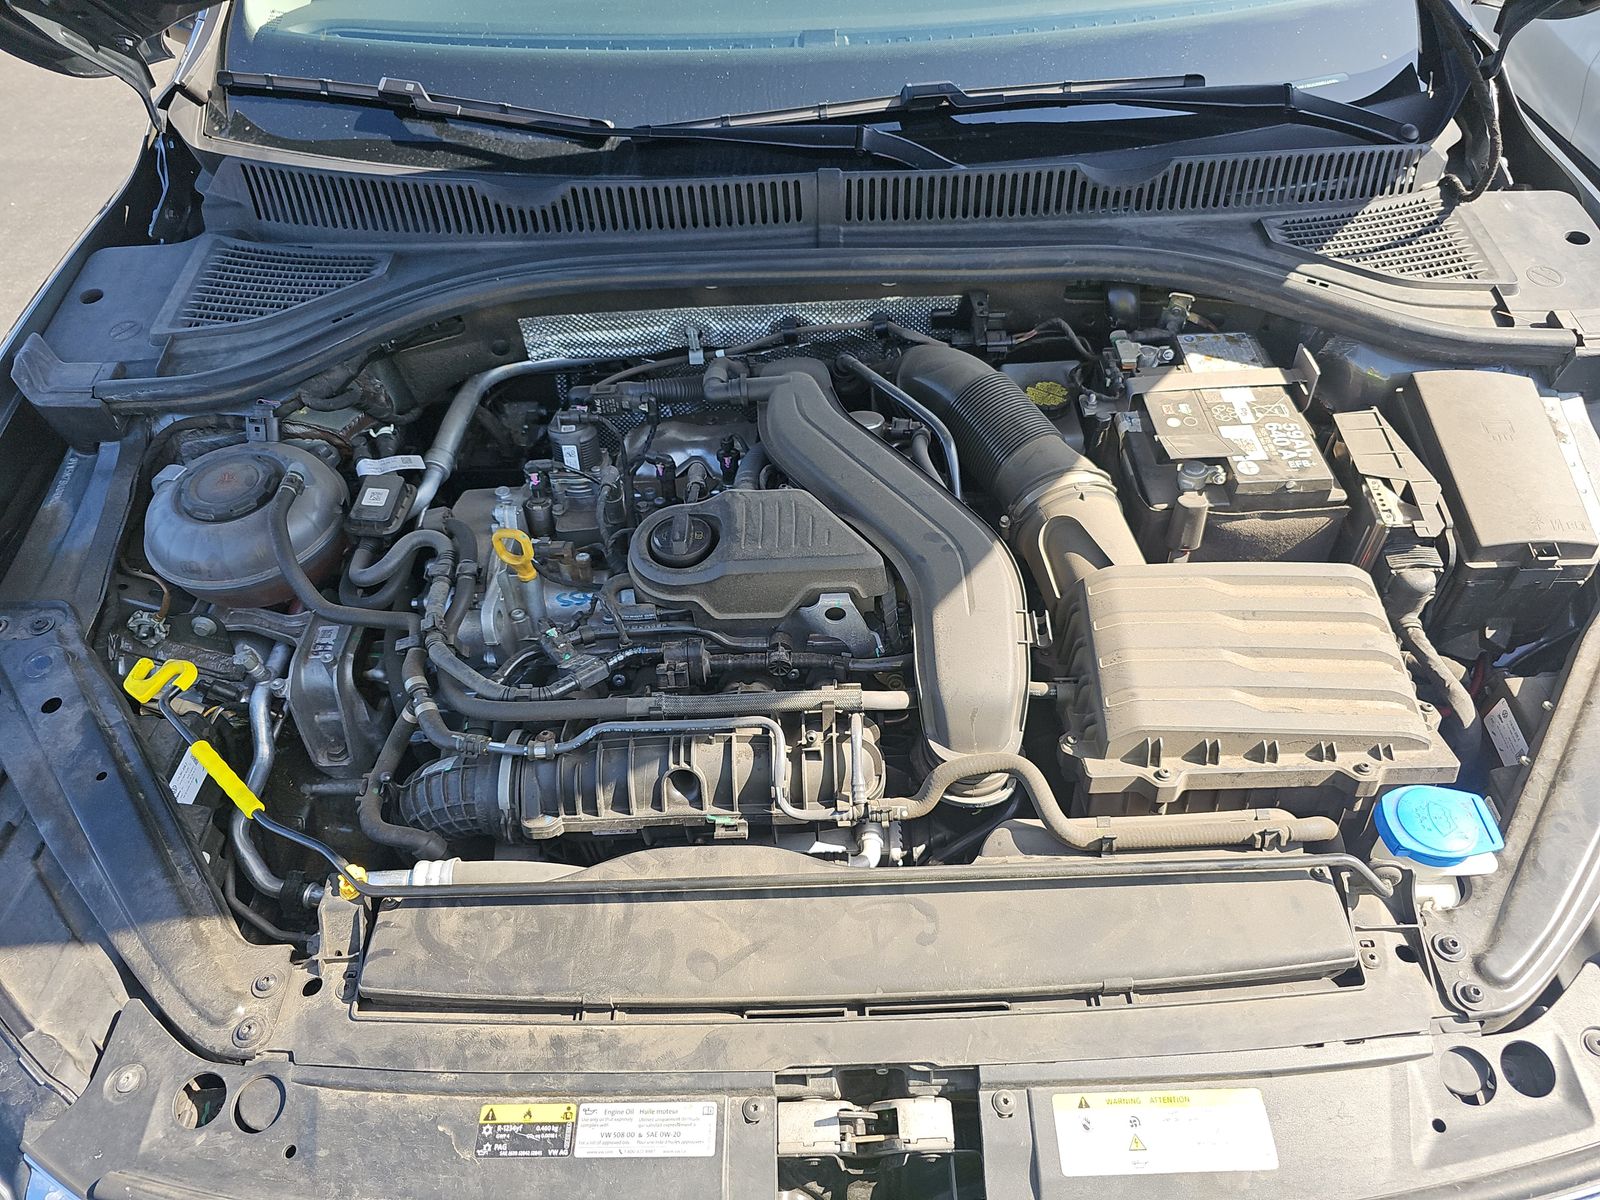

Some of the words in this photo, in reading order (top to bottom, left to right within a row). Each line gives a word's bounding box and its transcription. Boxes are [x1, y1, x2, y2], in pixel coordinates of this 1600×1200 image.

[1264, 422, 1291, 447] 640
[1282, 422, 1313, 458] 59Ah
[1277, 449, 1298, 460] A
[1105, 1097, 1142, 1105] WARNING
[1150, 1095, 1190, 1104] ATTENTION
[604, 1108, 624, 1116] Engine
[497, 1124, 524, 1134] R-1234yf
[494, 1143, 508, 1151] PAG
